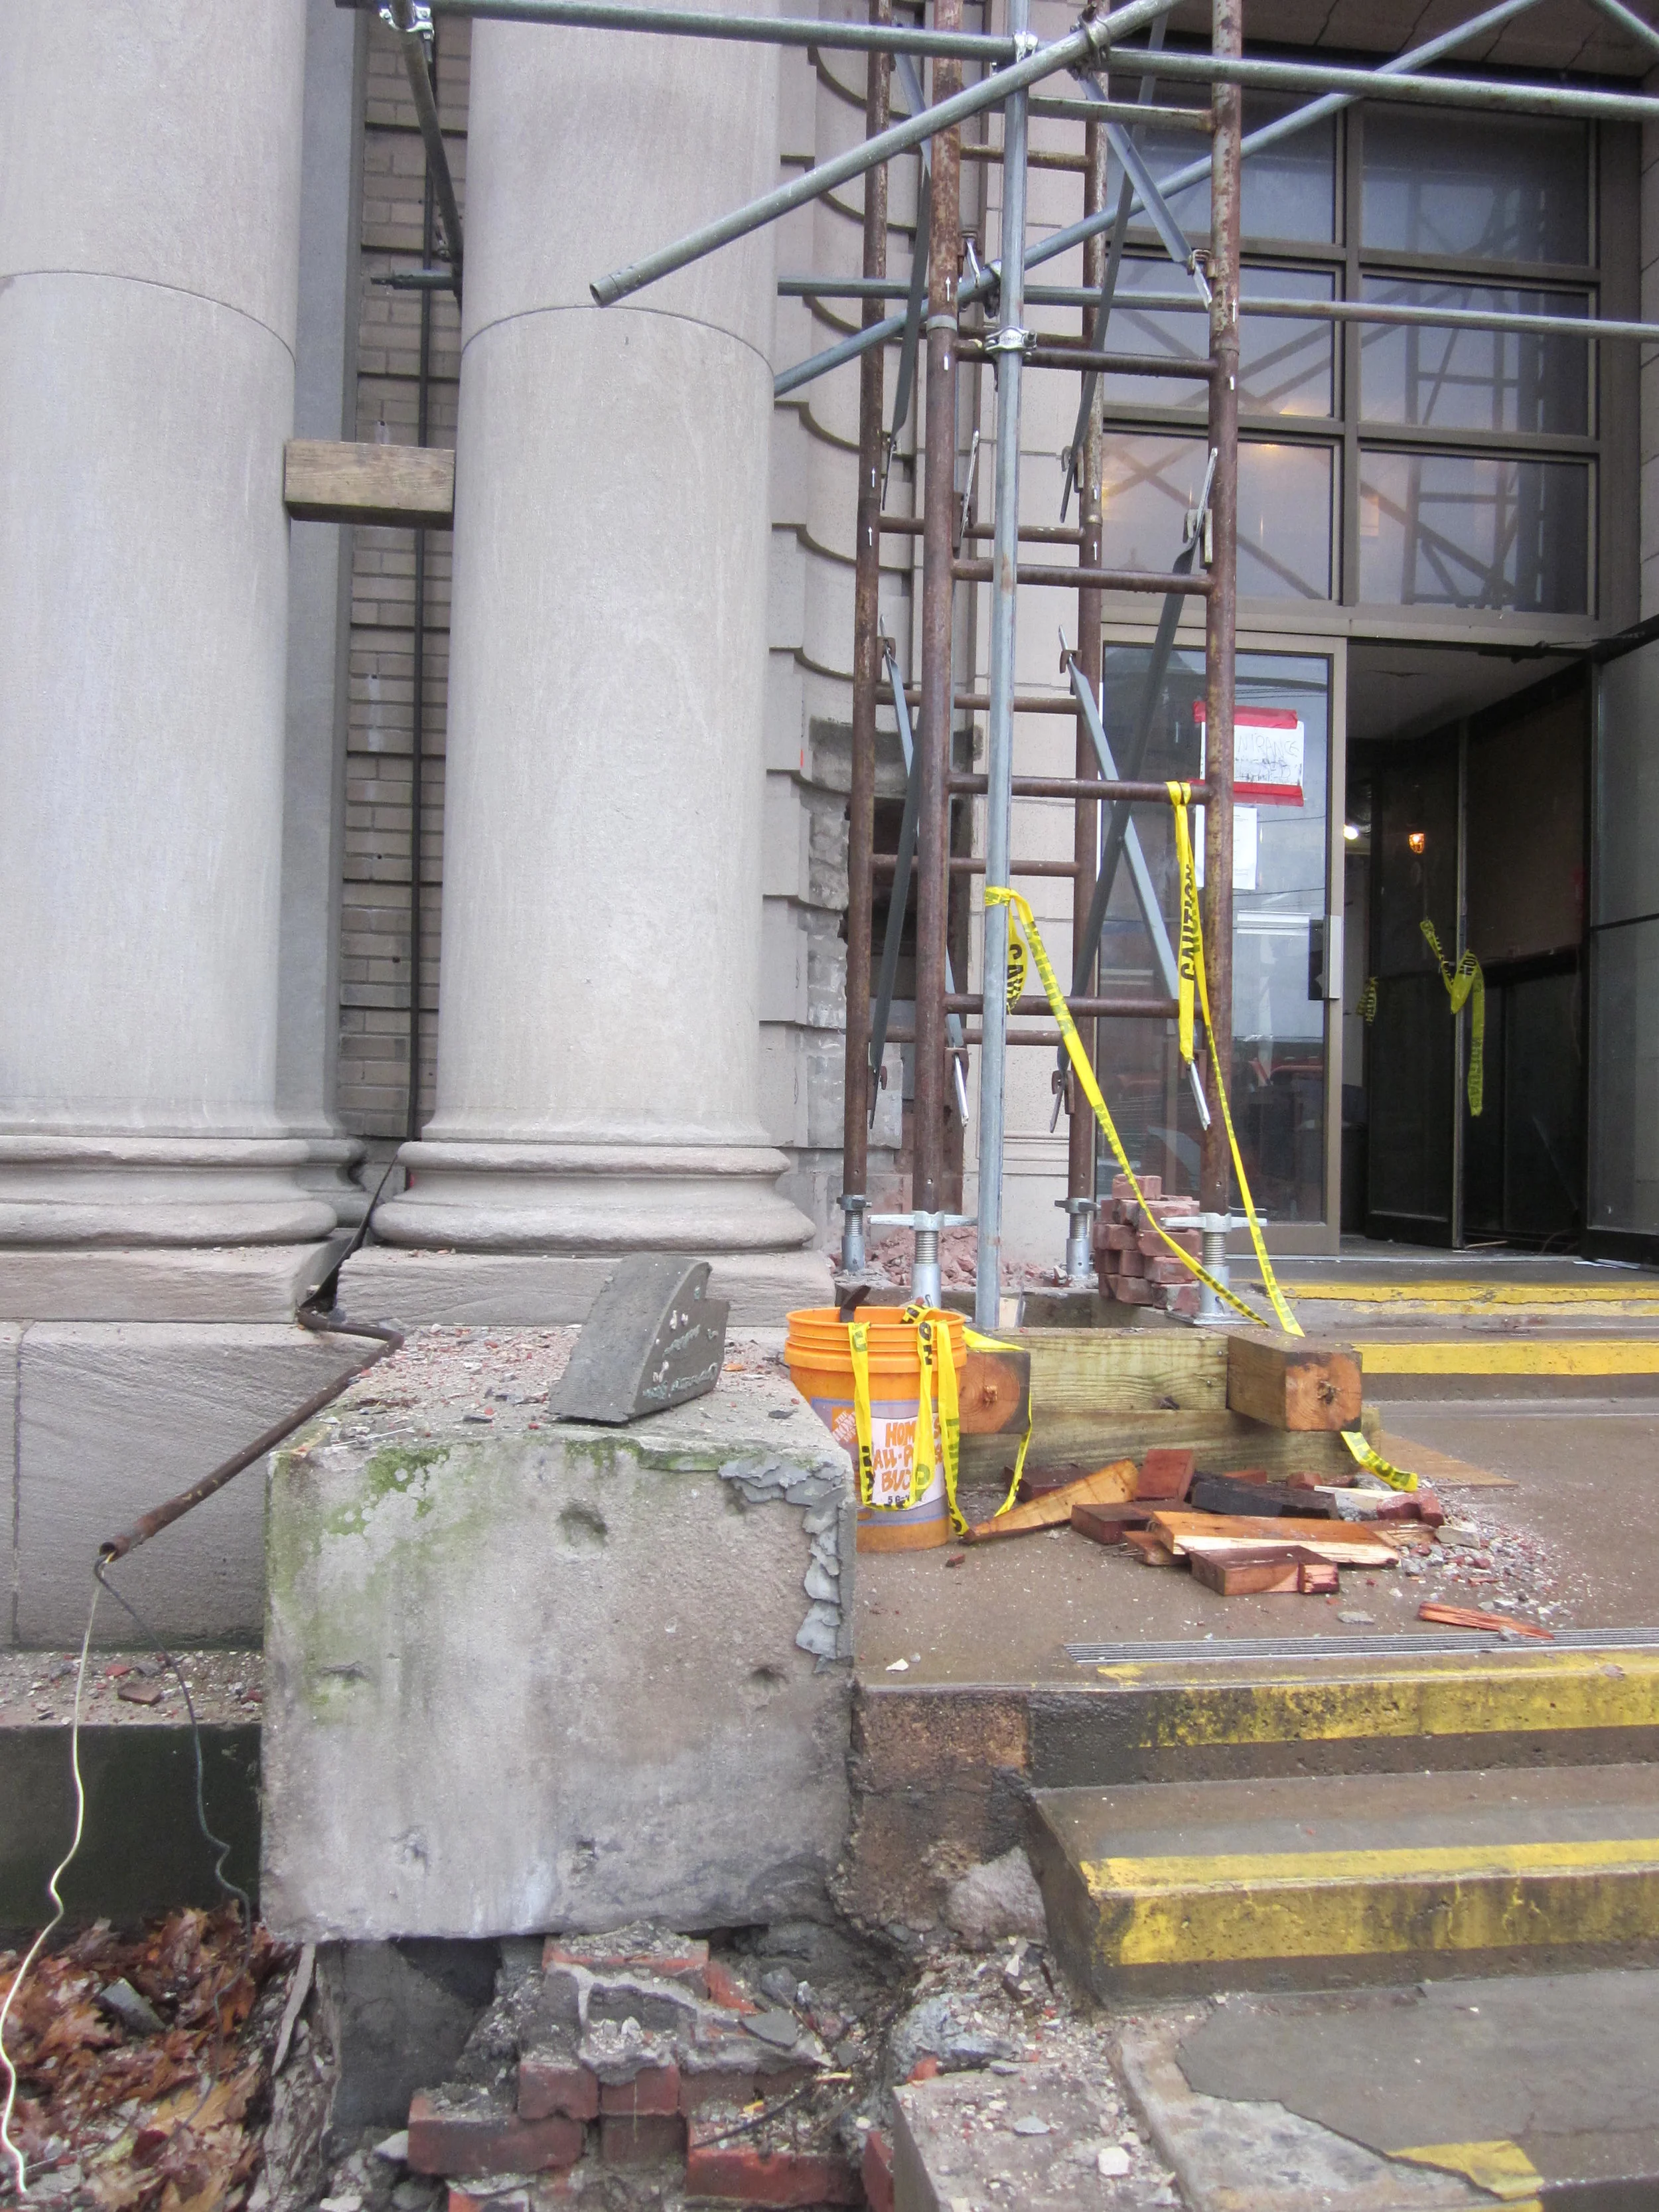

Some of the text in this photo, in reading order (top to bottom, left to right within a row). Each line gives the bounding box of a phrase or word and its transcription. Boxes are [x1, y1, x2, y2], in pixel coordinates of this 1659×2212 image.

[1237, 733, 1300, 759] NTRANCE
[1239, 759, 1291, 779] LOSED
[881, 1469, 912, 1493] BUC
